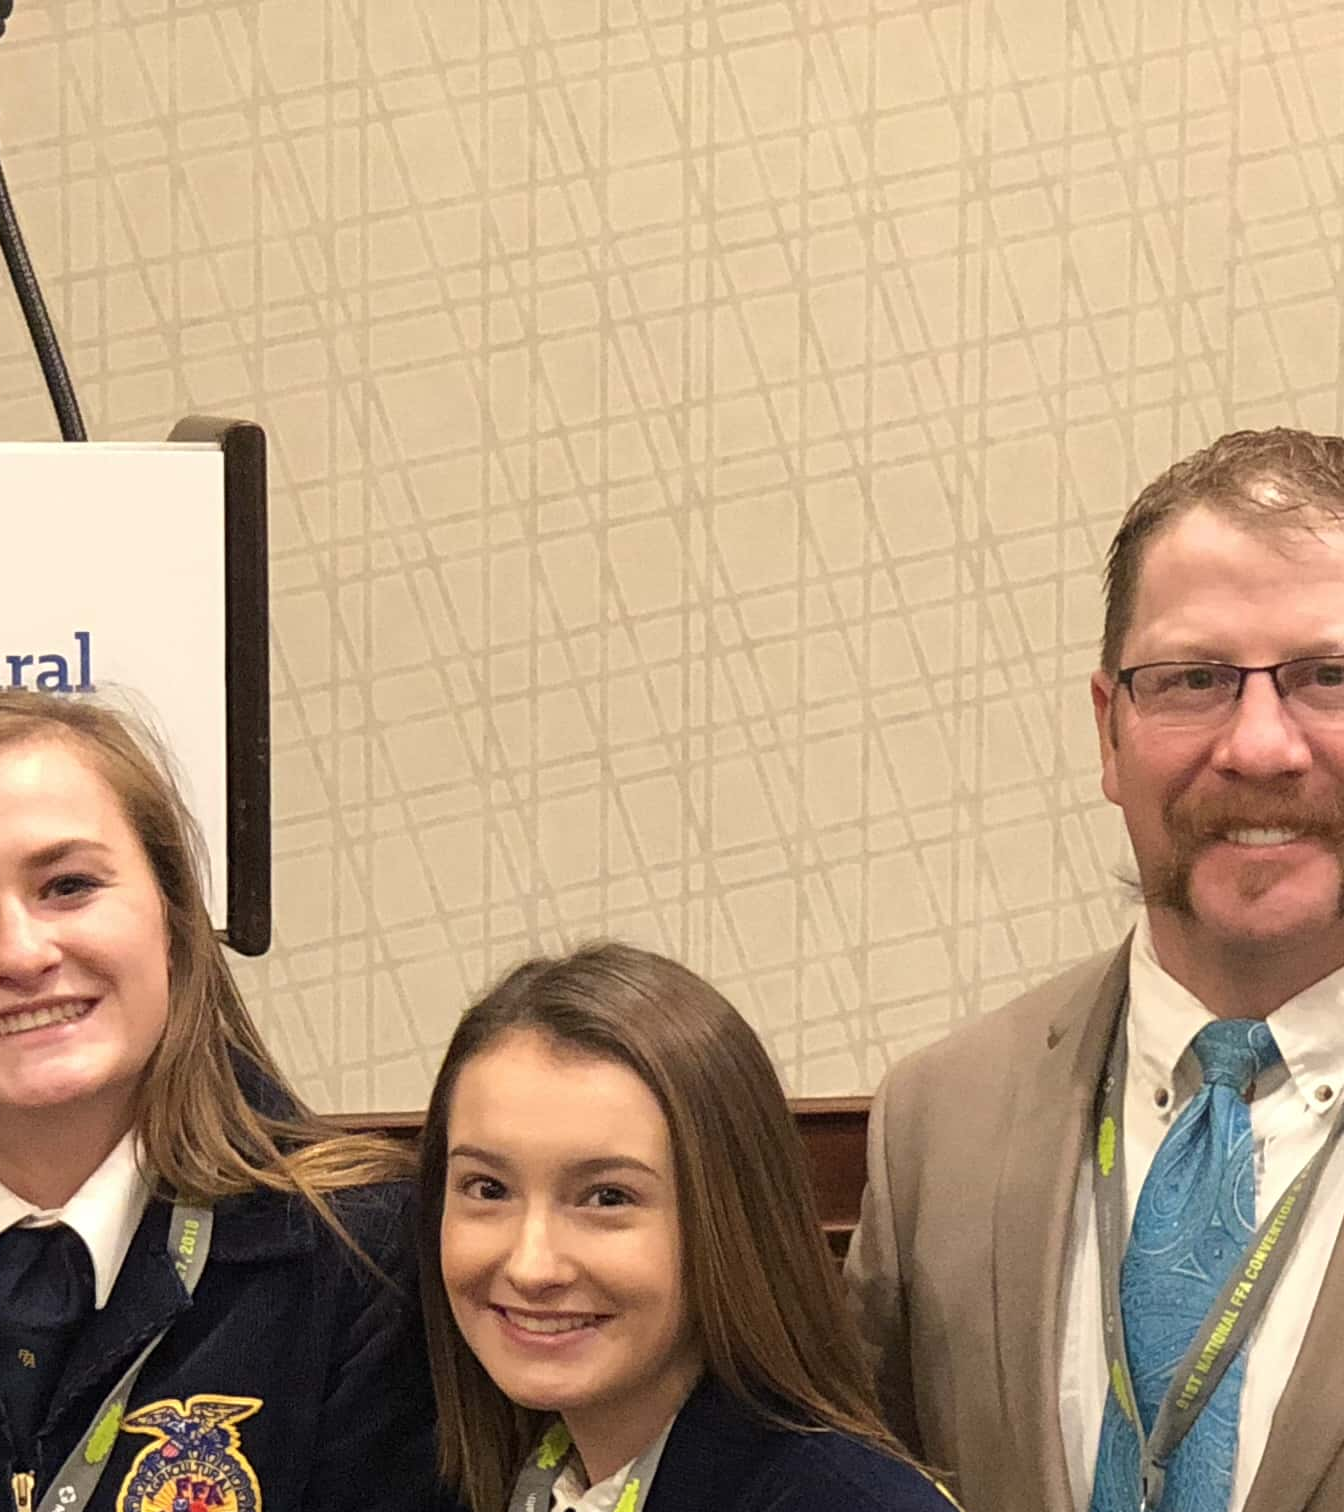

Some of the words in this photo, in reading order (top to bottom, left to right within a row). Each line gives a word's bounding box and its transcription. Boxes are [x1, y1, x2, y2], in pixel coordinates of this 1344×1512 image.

[1195, 1309, 1241, 1375] NATIONAL
[1229, 1281, 1254, 1308] FFA
[1244, 1195, 1298, 1281] CONVENTION
[175, 1477, 224, 1506] FFA
